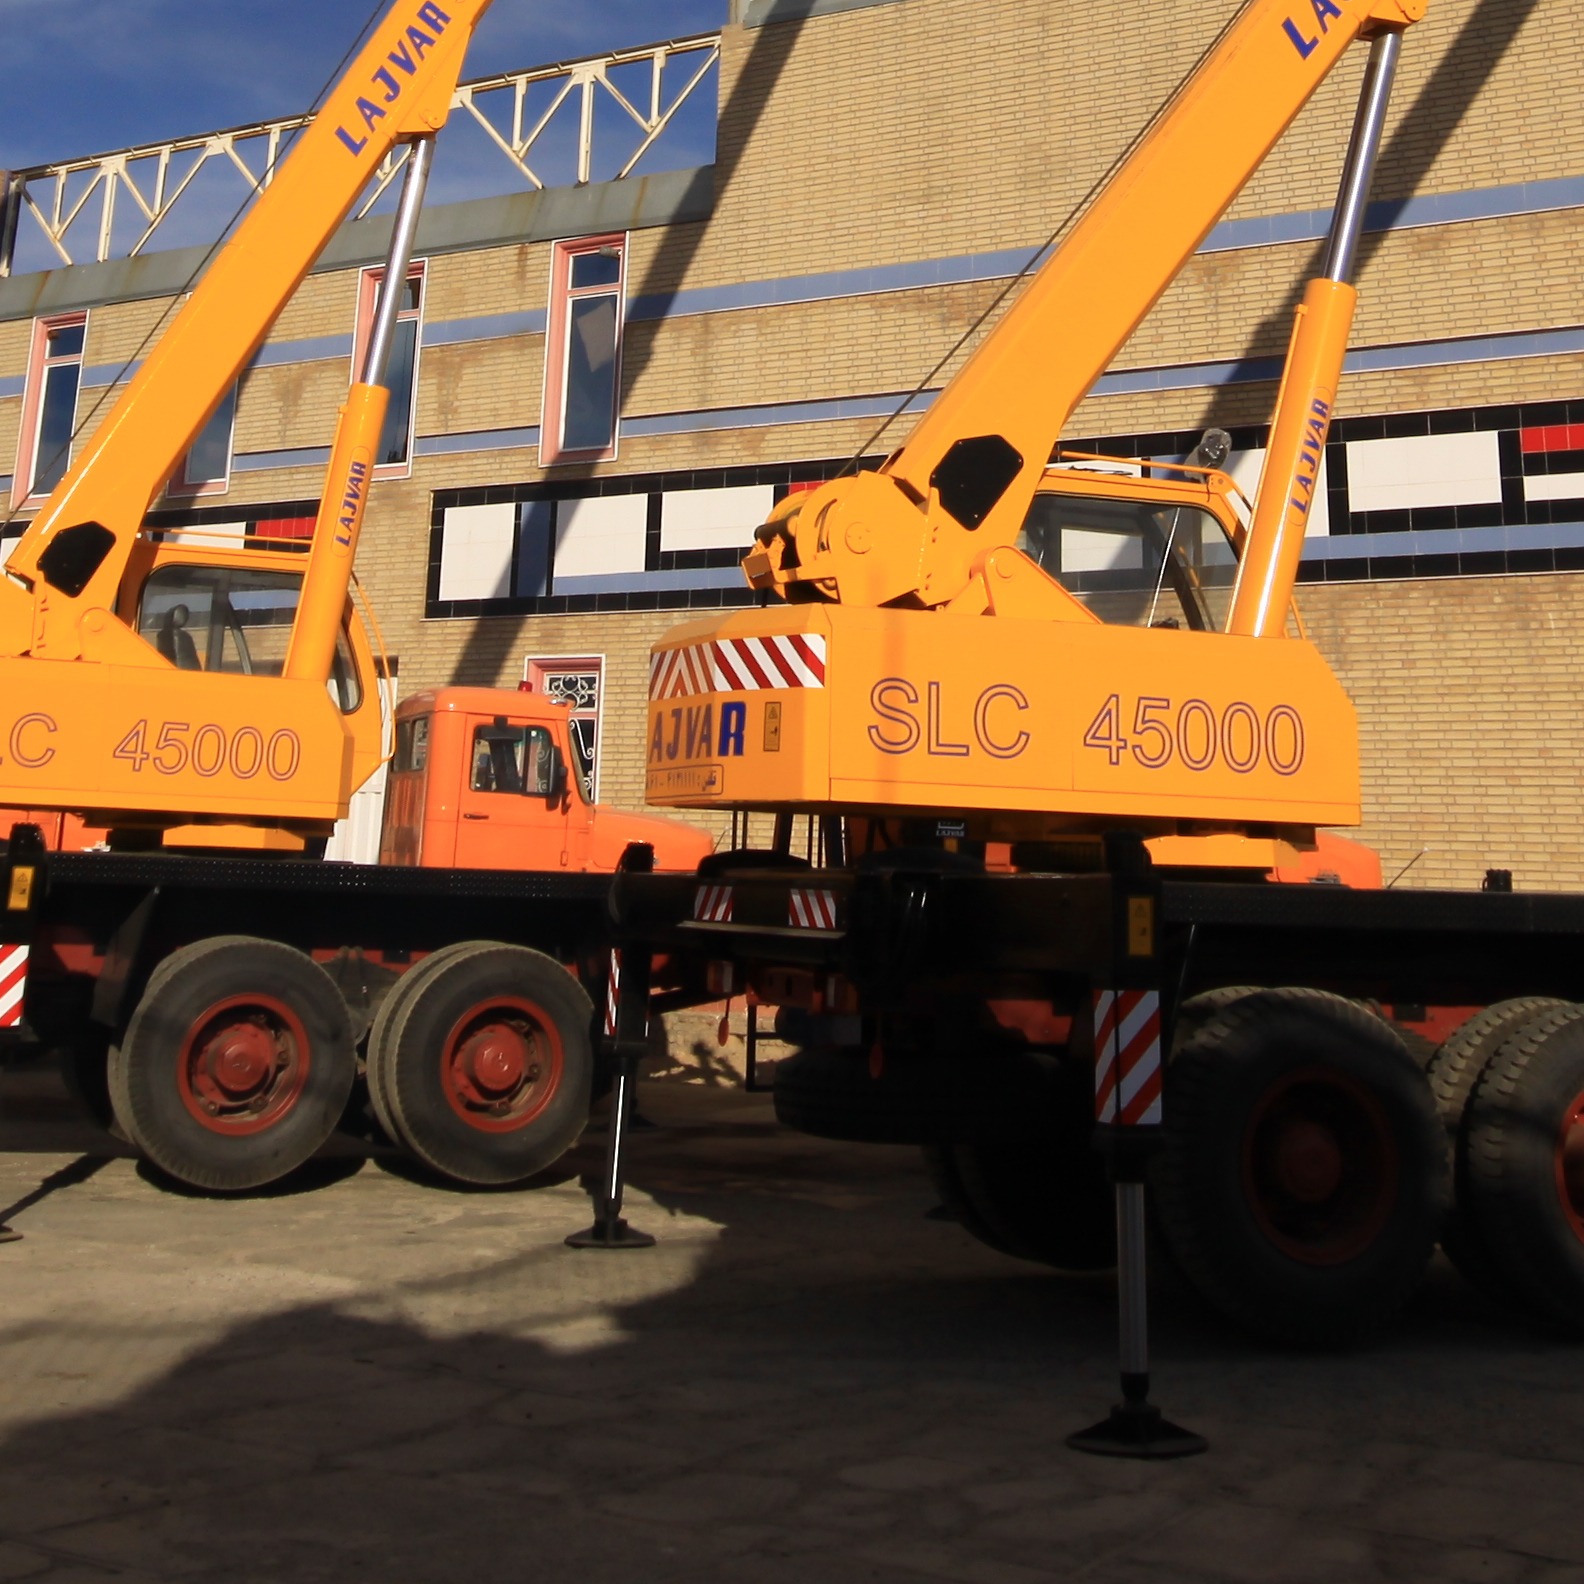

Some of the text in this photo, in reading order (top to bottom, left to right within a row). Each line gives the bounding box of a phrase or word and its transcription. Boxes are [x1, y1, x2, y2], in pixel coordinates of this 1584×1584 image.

[334, 0, 452, 157] LAJVAR
[1290, 398, 1329, 514] LAJVAR
[335, 461, 367, 547] LAJVAR
[112, 719, 301, 781] 45000
[648, 701, 747, 764] AJVAR
[867, 677, 1304, 776] SLC 45000
